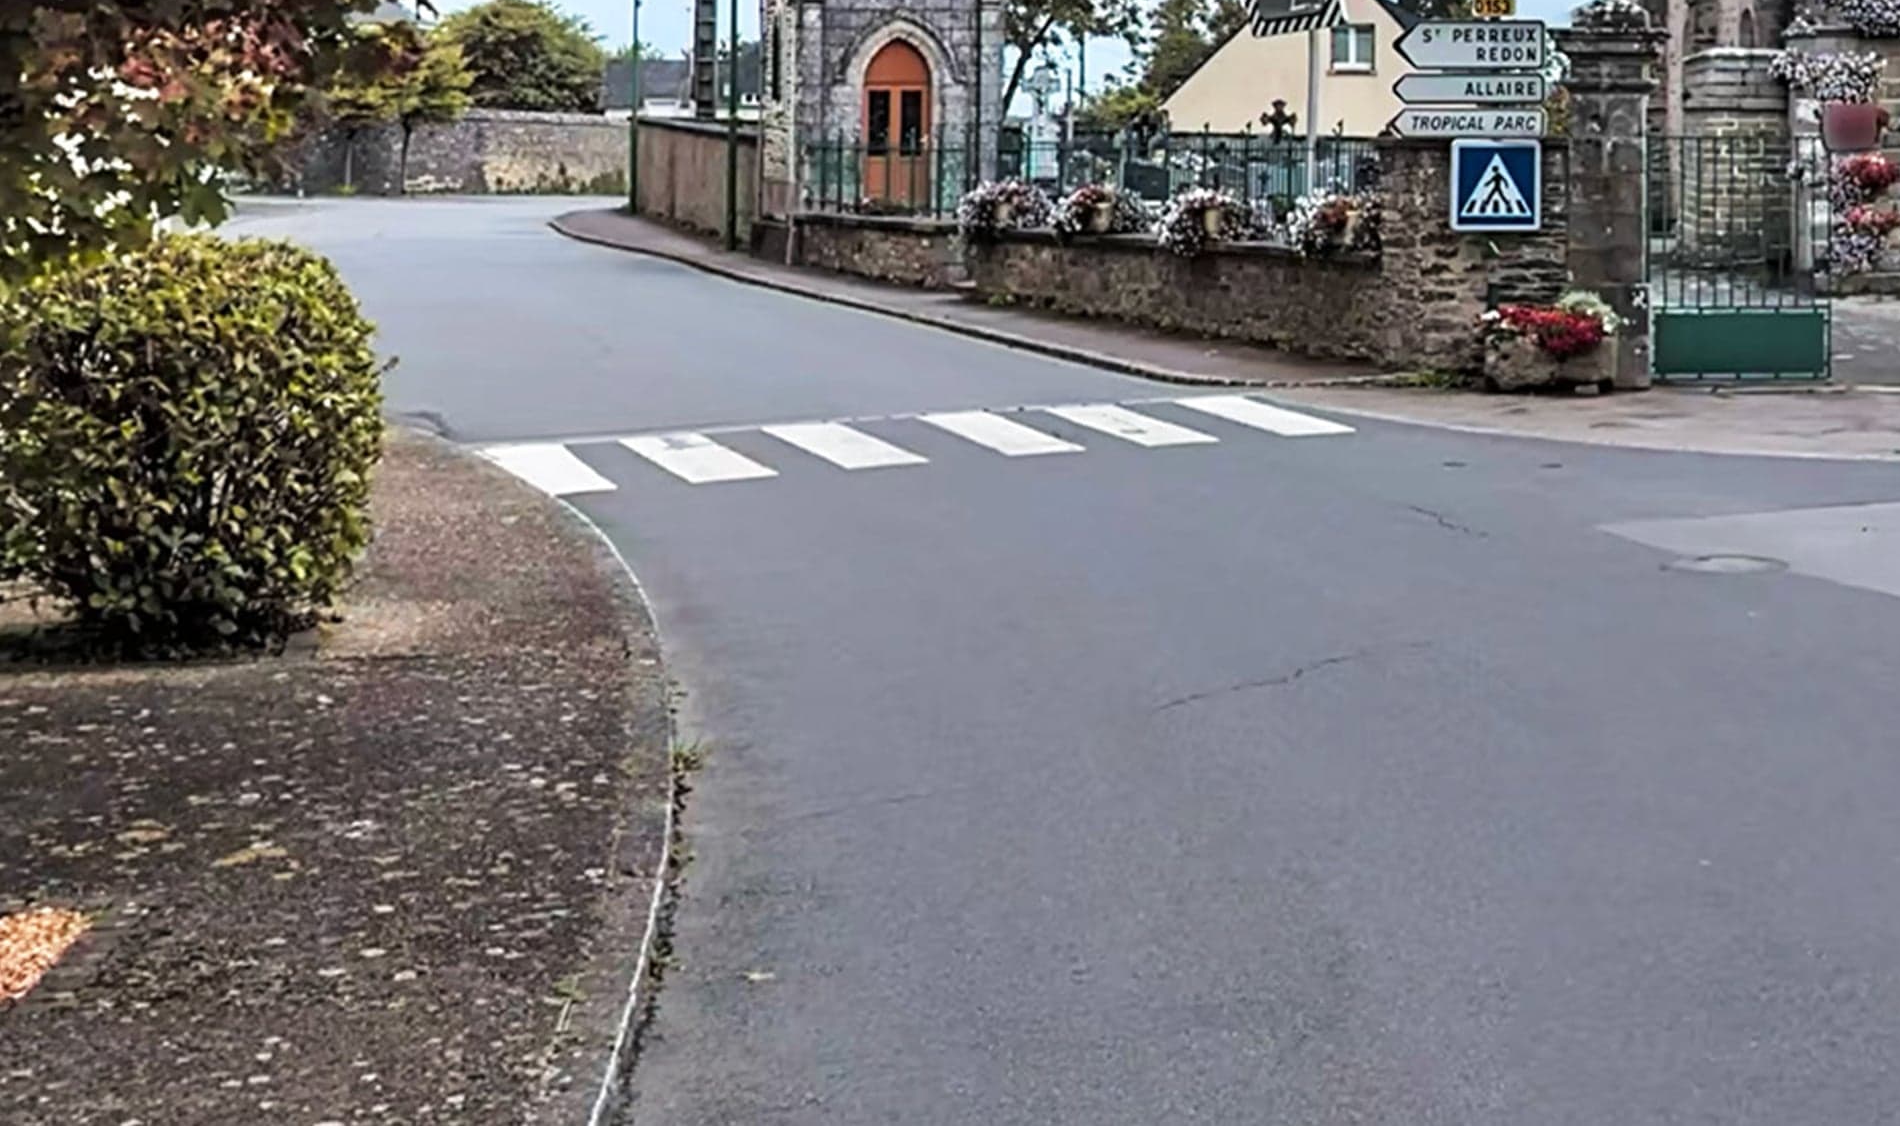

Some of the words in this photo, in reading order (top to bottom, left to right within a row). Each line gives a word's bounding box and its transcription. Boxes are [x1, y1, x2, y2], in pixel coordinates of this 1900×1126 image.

[1453, 27, 1536, 43] PERREUX
[1476, 46, 1537, 62] REDON
[1464, 80, 1537, 96] ALLAIRE
[1411, 115, 1485, 131] TROPICAL
[1493, 115, 1537, 131] PARC
